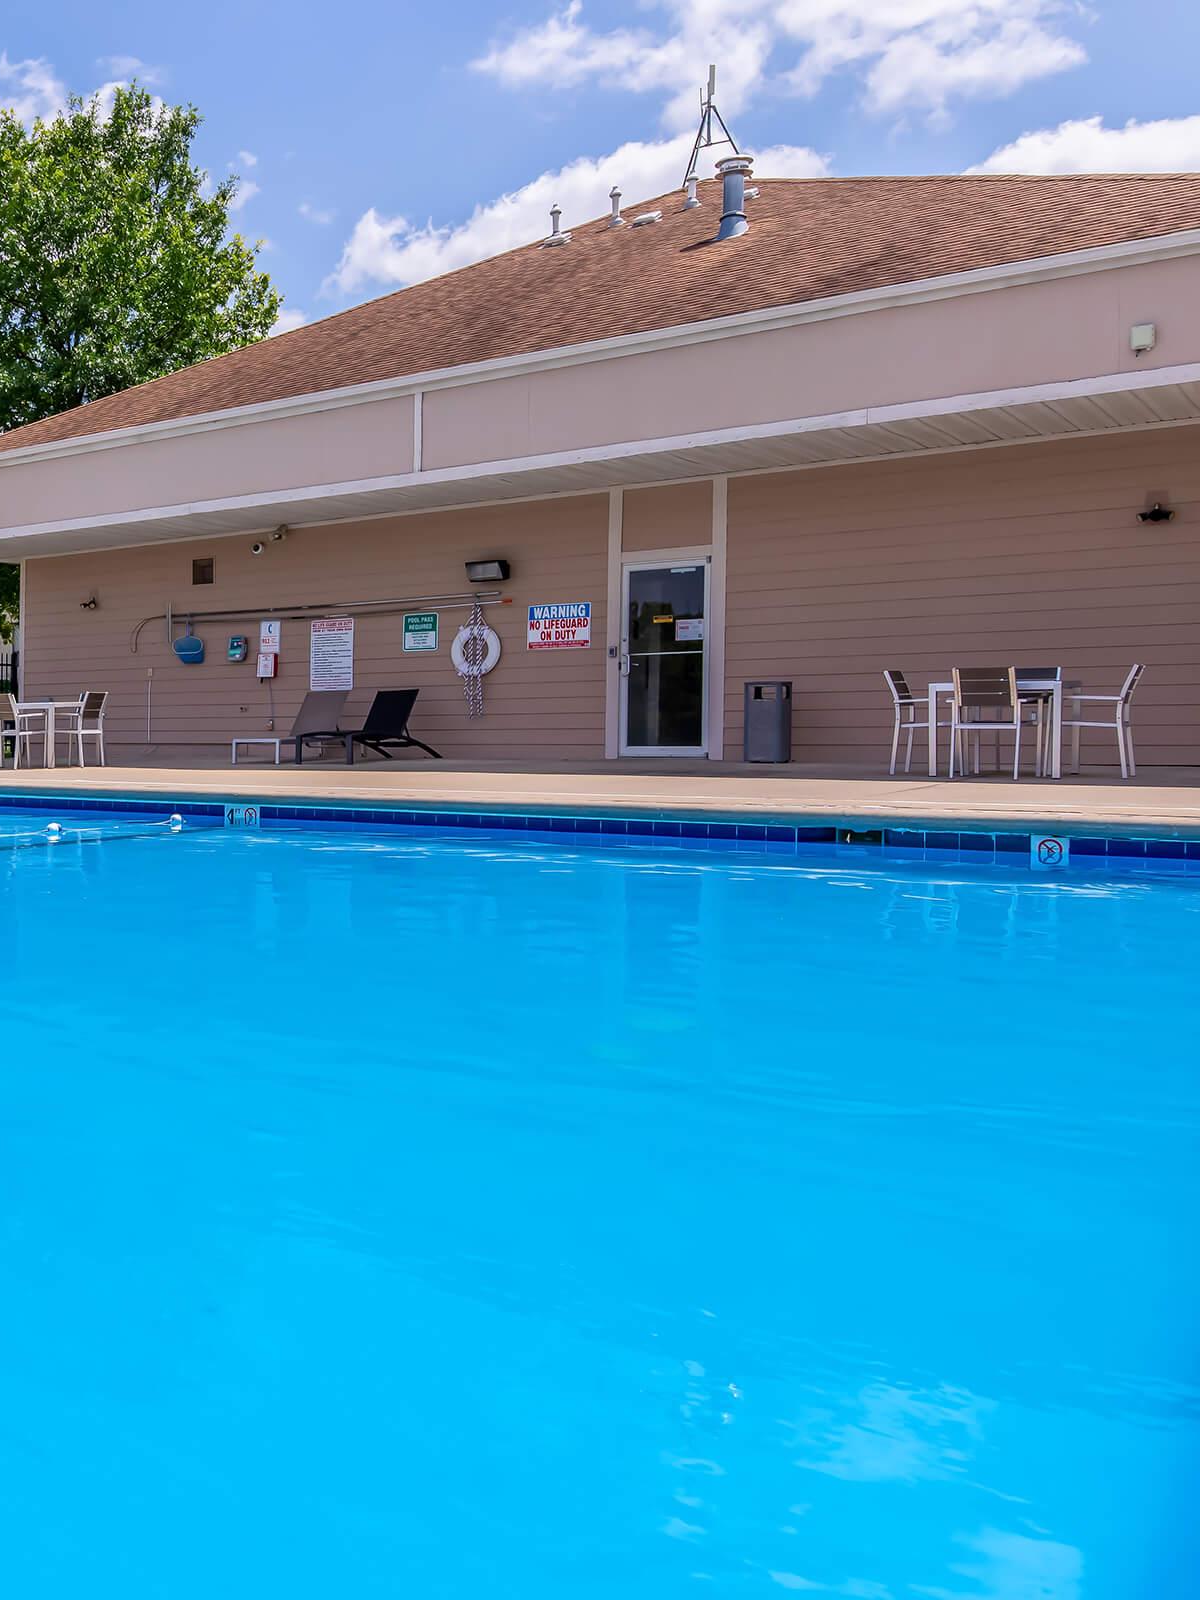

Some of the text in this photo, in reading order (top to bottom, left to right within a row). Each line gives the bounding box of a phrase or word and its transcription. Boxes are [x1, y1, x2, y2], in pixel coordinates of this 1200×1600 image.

[533, 604, 586, 619] WARNING
[529, 618, 589, 631] NO LIFEGUARD
[540, 629, 577, 641] ON DUTY
